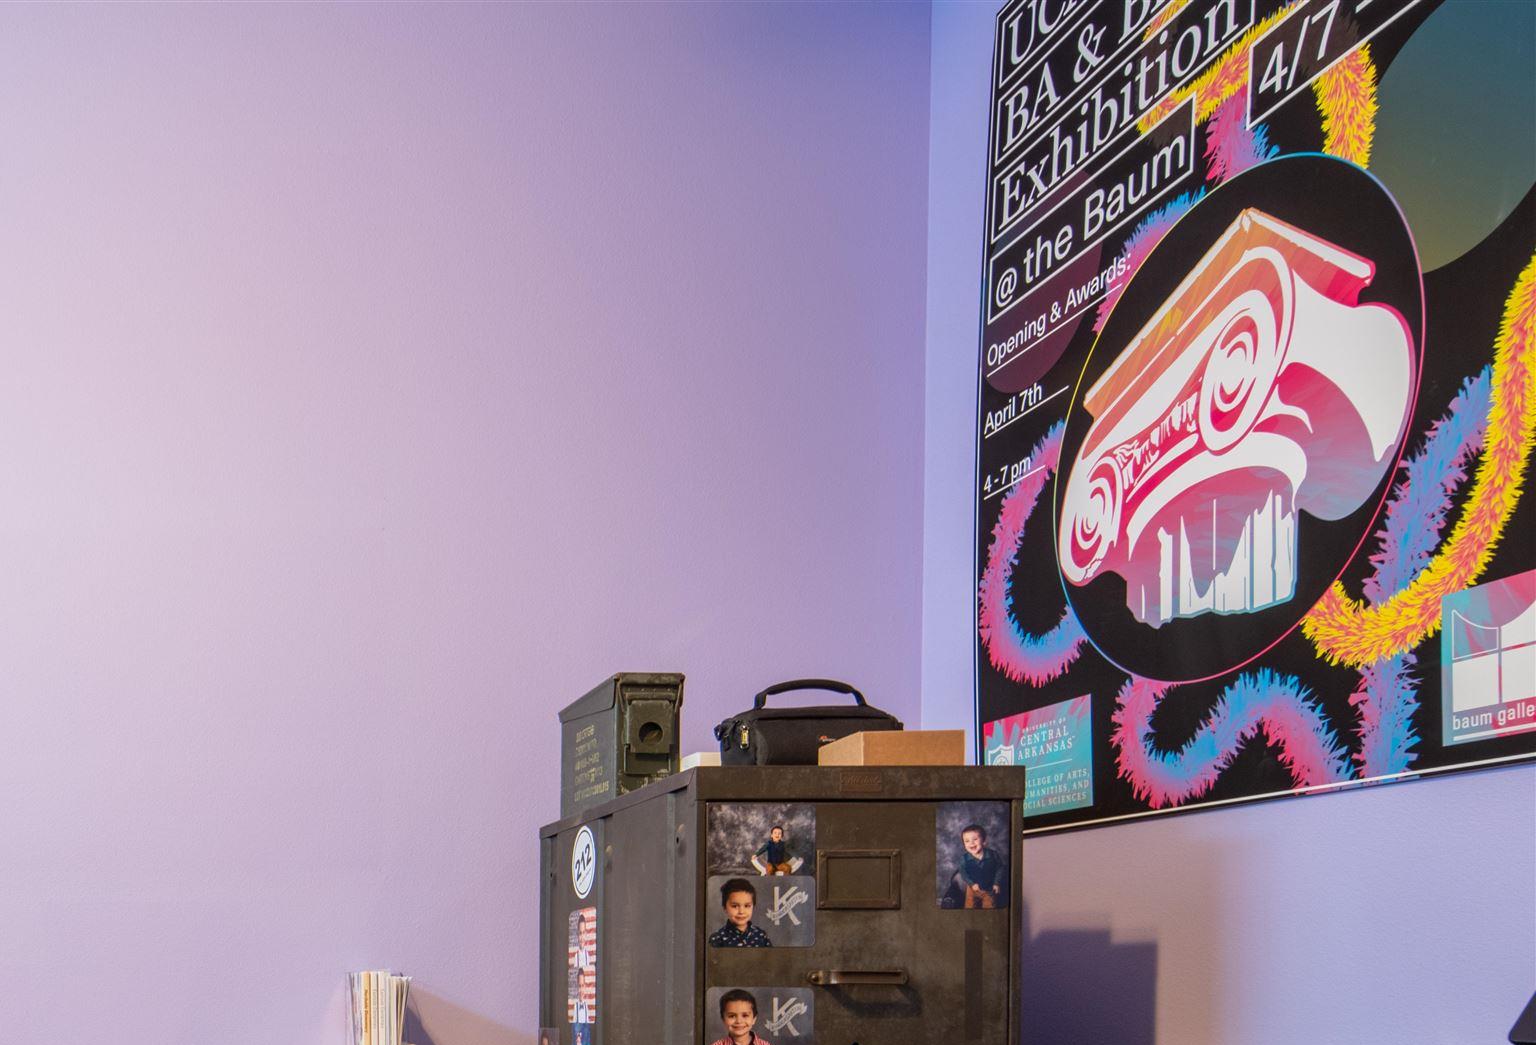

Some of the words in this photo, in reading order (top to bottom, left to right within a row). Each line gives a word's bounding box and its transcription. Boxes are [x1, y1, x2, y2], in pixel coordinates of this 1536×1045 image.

[1259, 0, 1341, 95] 4/7
[1005, 61, 1061, 147] BA
[1073, 22, 1107, 83] &
[998, 0, 1239, 231] Exhibition
[996, 267, 1017, 307] @
[1023, 222, 1073, 280] the
[1083, 134, 1186, 242] Baum
[987, 315, 1047, 367] Opening
[1050, 299, 1061, 323] &
[1064, 252, 1132, 316] Awards:
[984, 399, 1015, 435] April
[1019, 382, 1042, 411] 7th
[1011, 456, 1031, 483] pm
[1020, 725, 1069, 746] CENTRAL
[1452, 712, 1492, 731] baum
[1017, 737, 1073, 760] ARKANSAS
[1025, 776, 1050, 788] LLEGE
[1054, 773, 1064, 782] OF
[1067, 768, 1090, 779] ARTS,
[1025, 784, 1071, 799] MANITIES,
[1073, 779, 1090, 790] AND
[1024, 799, 1046, 810] OCIAL
[1048, 792, 1088, 806] SCIENCES
[575, 843, 591, 881] 212
